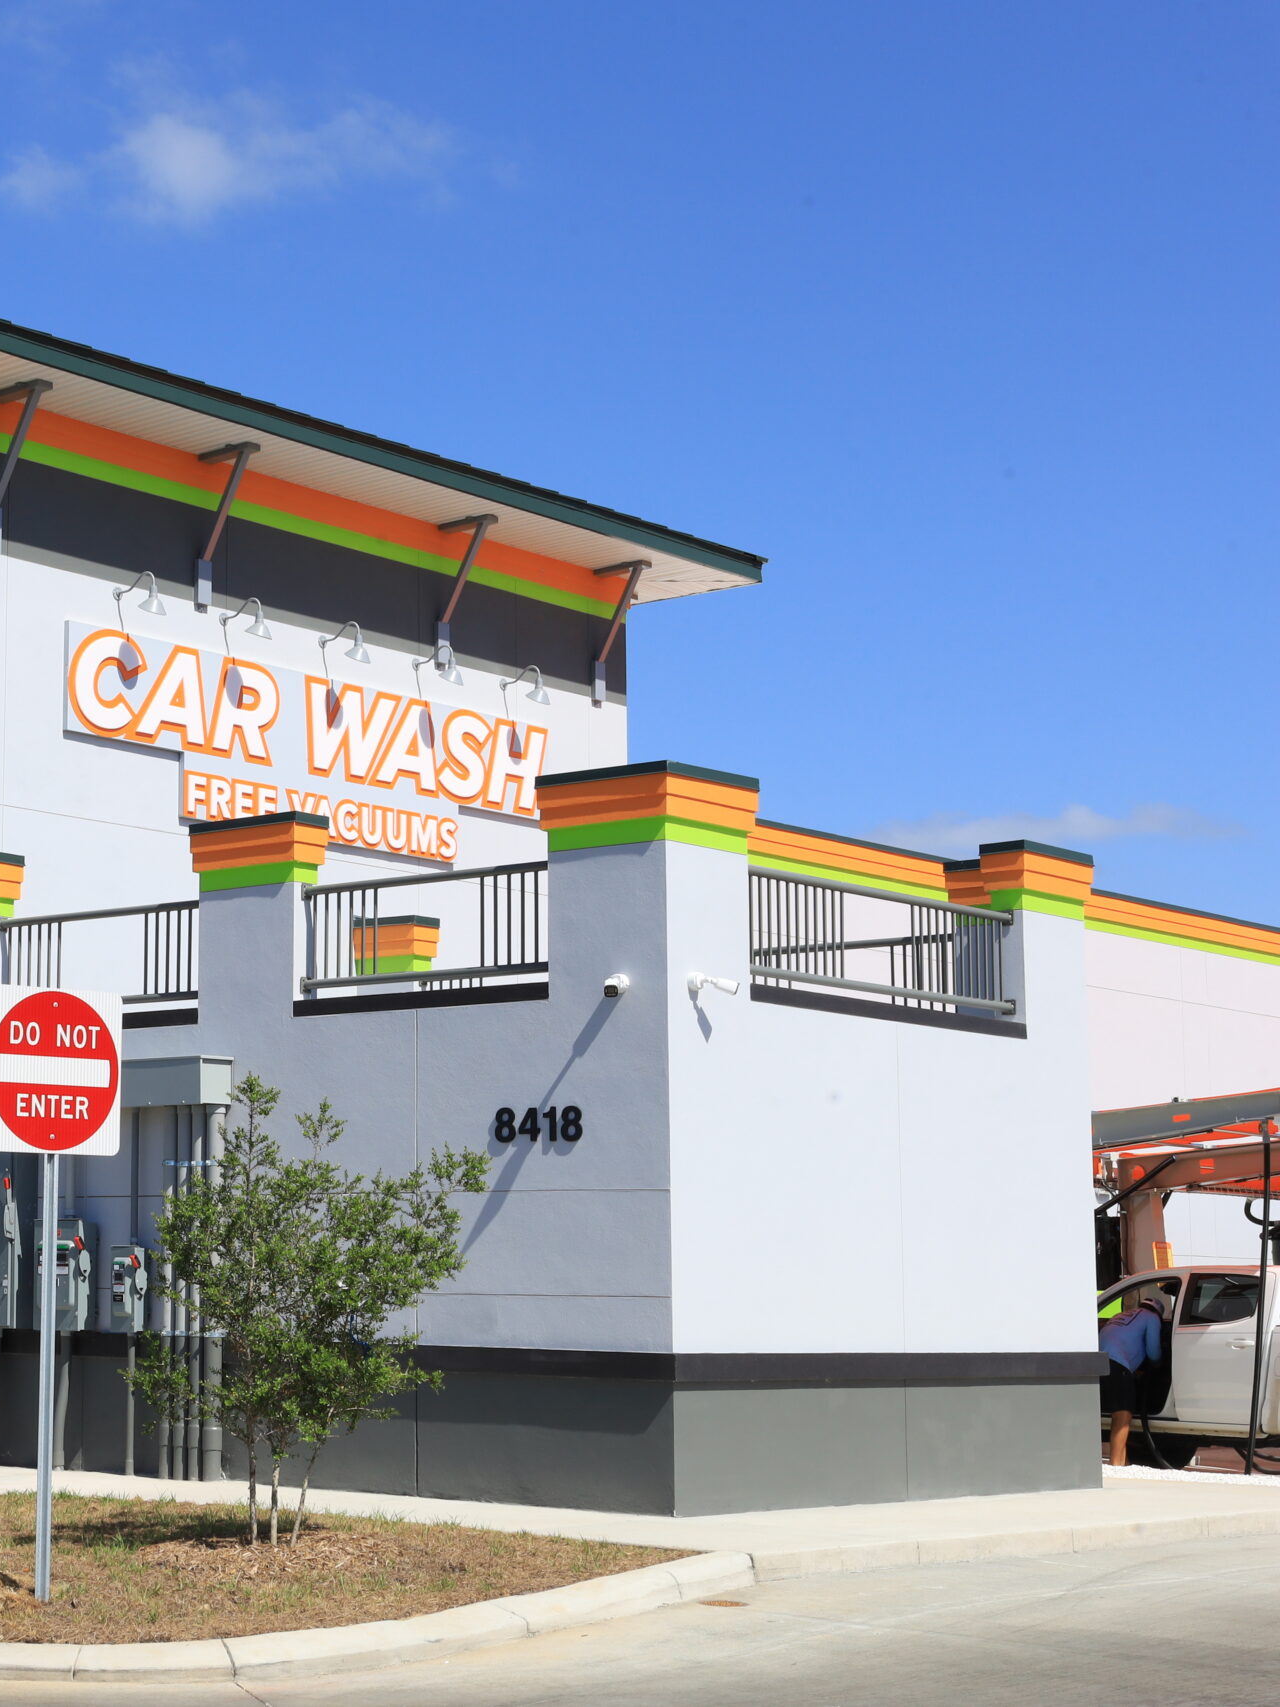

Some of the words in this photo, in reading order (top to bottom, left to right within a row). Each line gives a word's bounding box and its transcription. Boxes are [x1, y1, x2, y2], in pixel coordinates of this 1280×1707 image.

[68, 629, 280, 767] CAR
[304, 675, 548, 816] WASH
[184, 770, 279, 820] FREE
[9, 1020, 40, 1046] DO
[56, 1023, 101, 1049] NOT
[16, 1093, 89, 1120] ENTER
[494, 1105, 583, 1143] 8418
